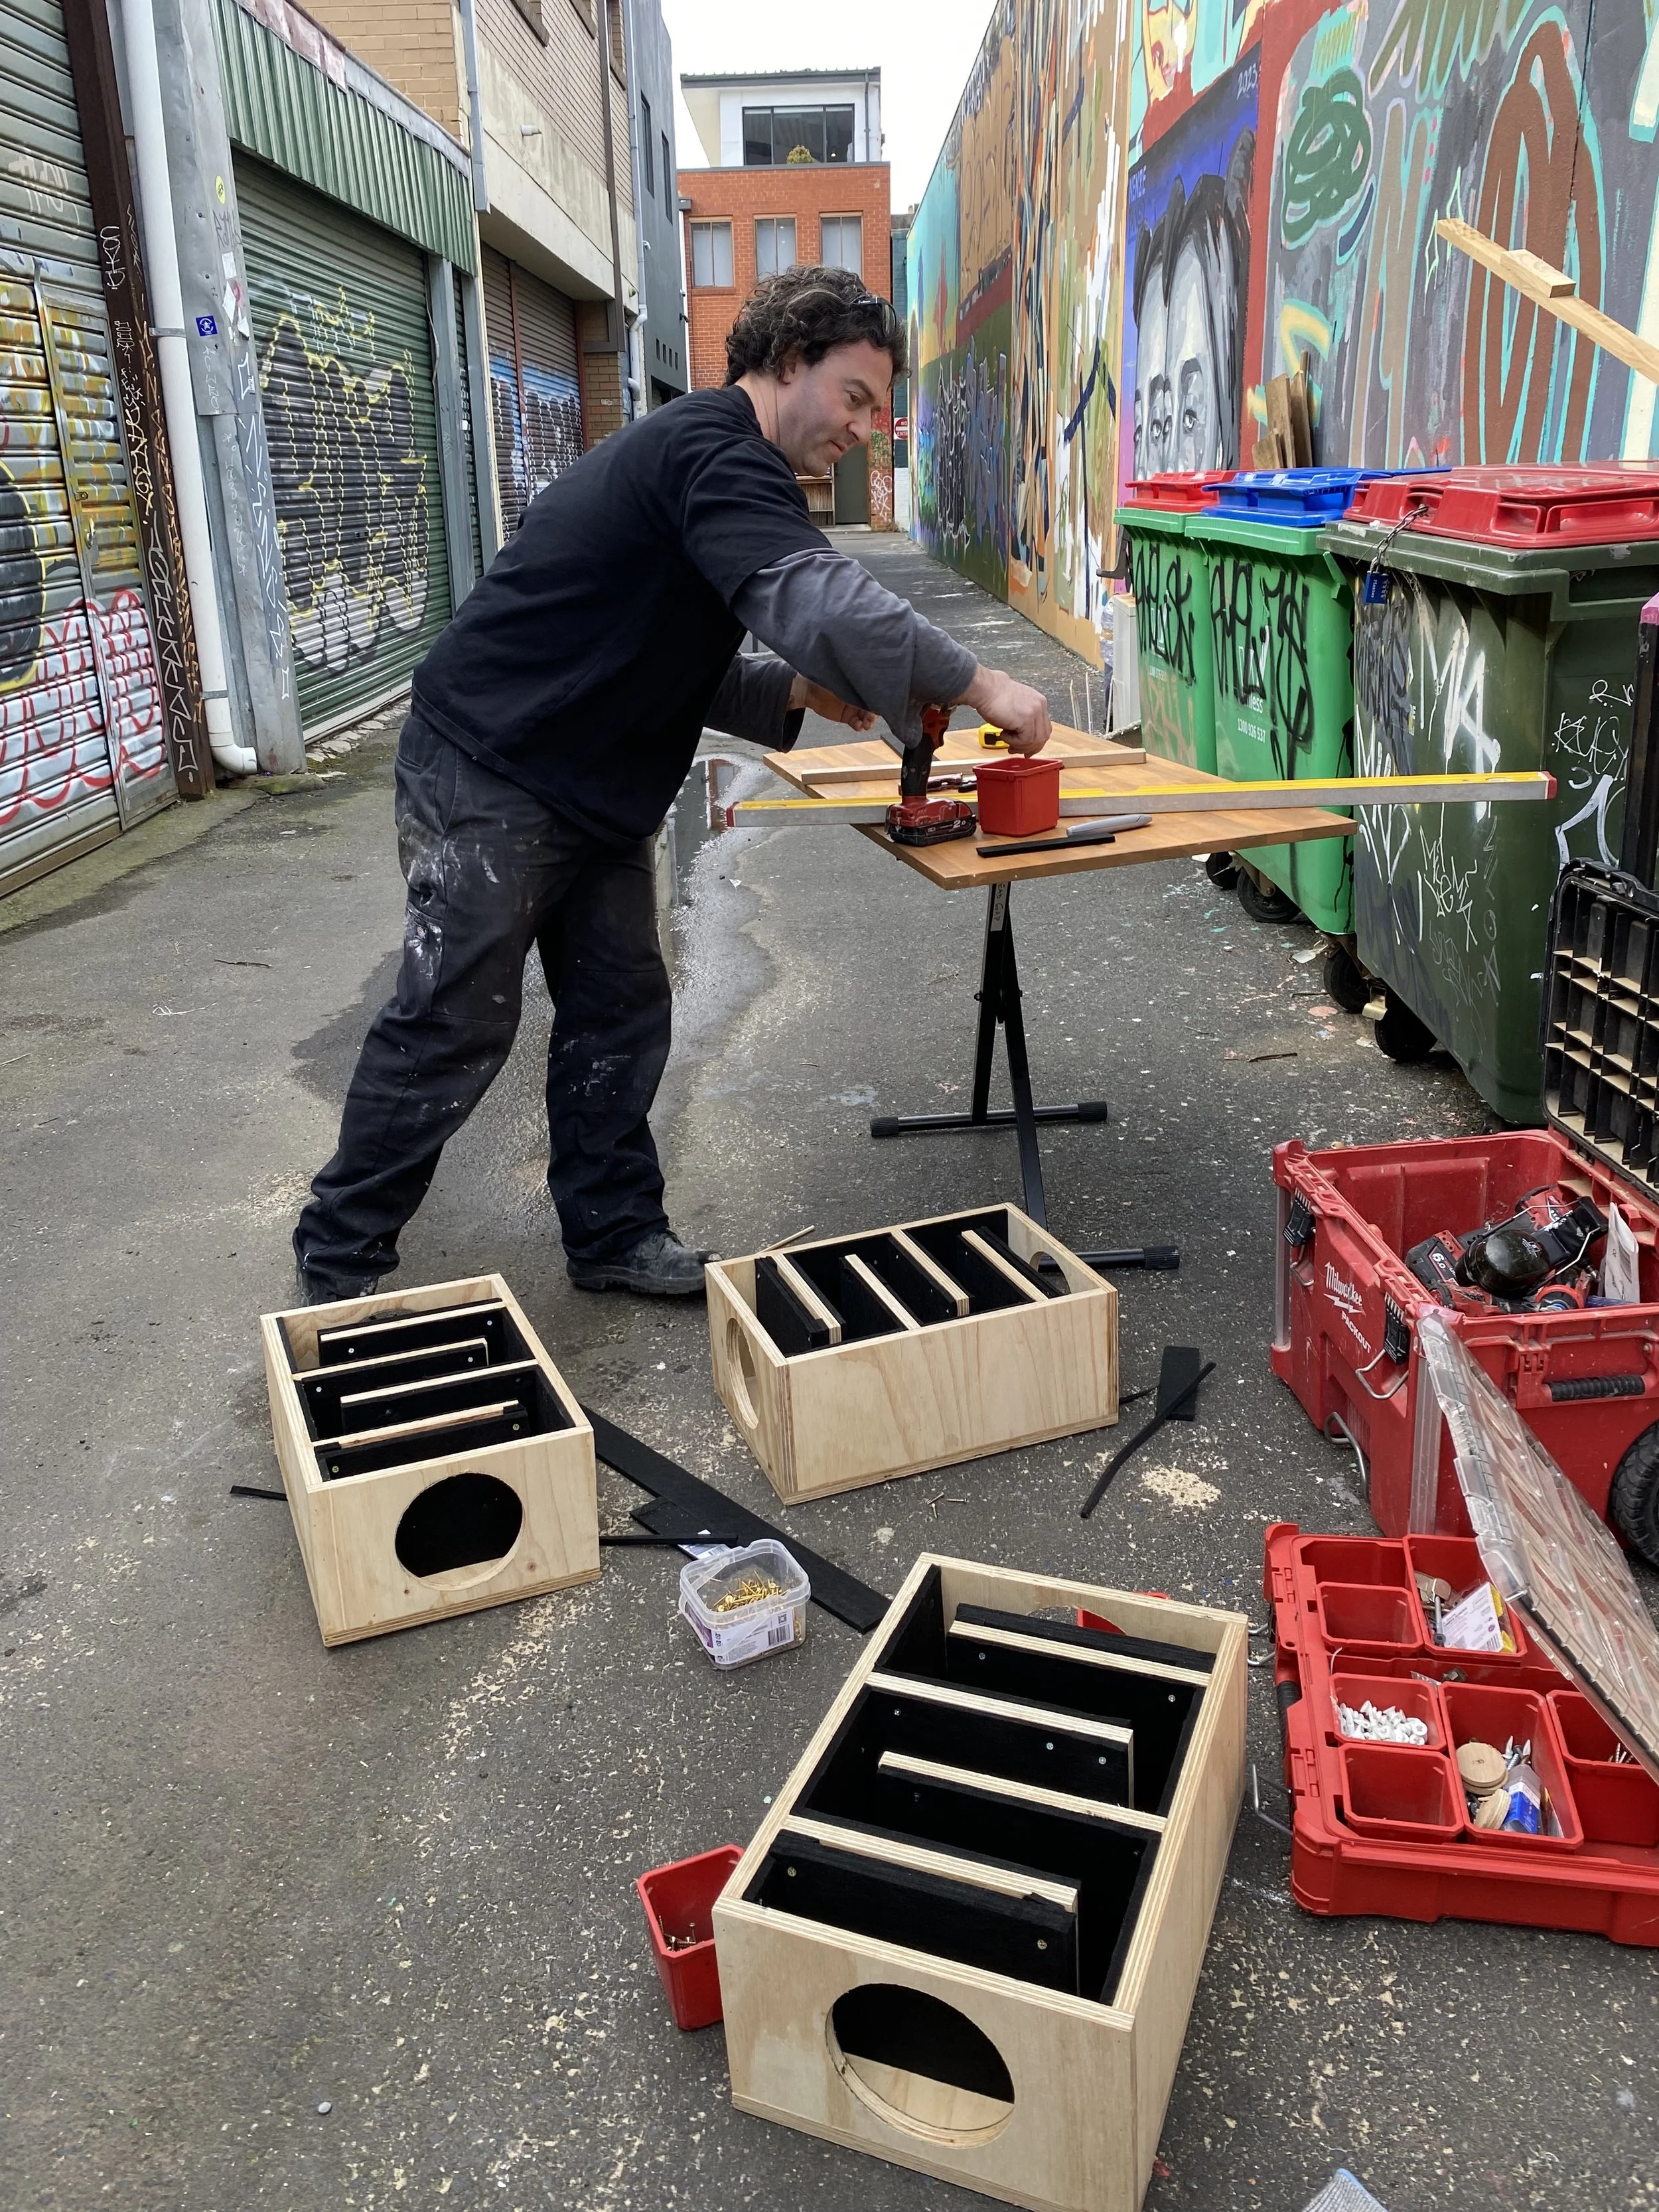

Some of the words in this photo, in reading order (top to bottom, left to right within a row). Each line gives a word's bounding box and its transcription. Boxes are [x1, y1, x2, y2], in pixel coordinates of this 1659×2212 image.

[1238, 718, 1248, 735] 1300
[1248, 723, 1257, 739] 926
[1257, 727, 1266, 743] 537
[953, 820, 966, 829] 2.0
[1432, 1253, 1446, 1269] 6.0
[1341, 1311, 1372, 1353] PACKOUT
